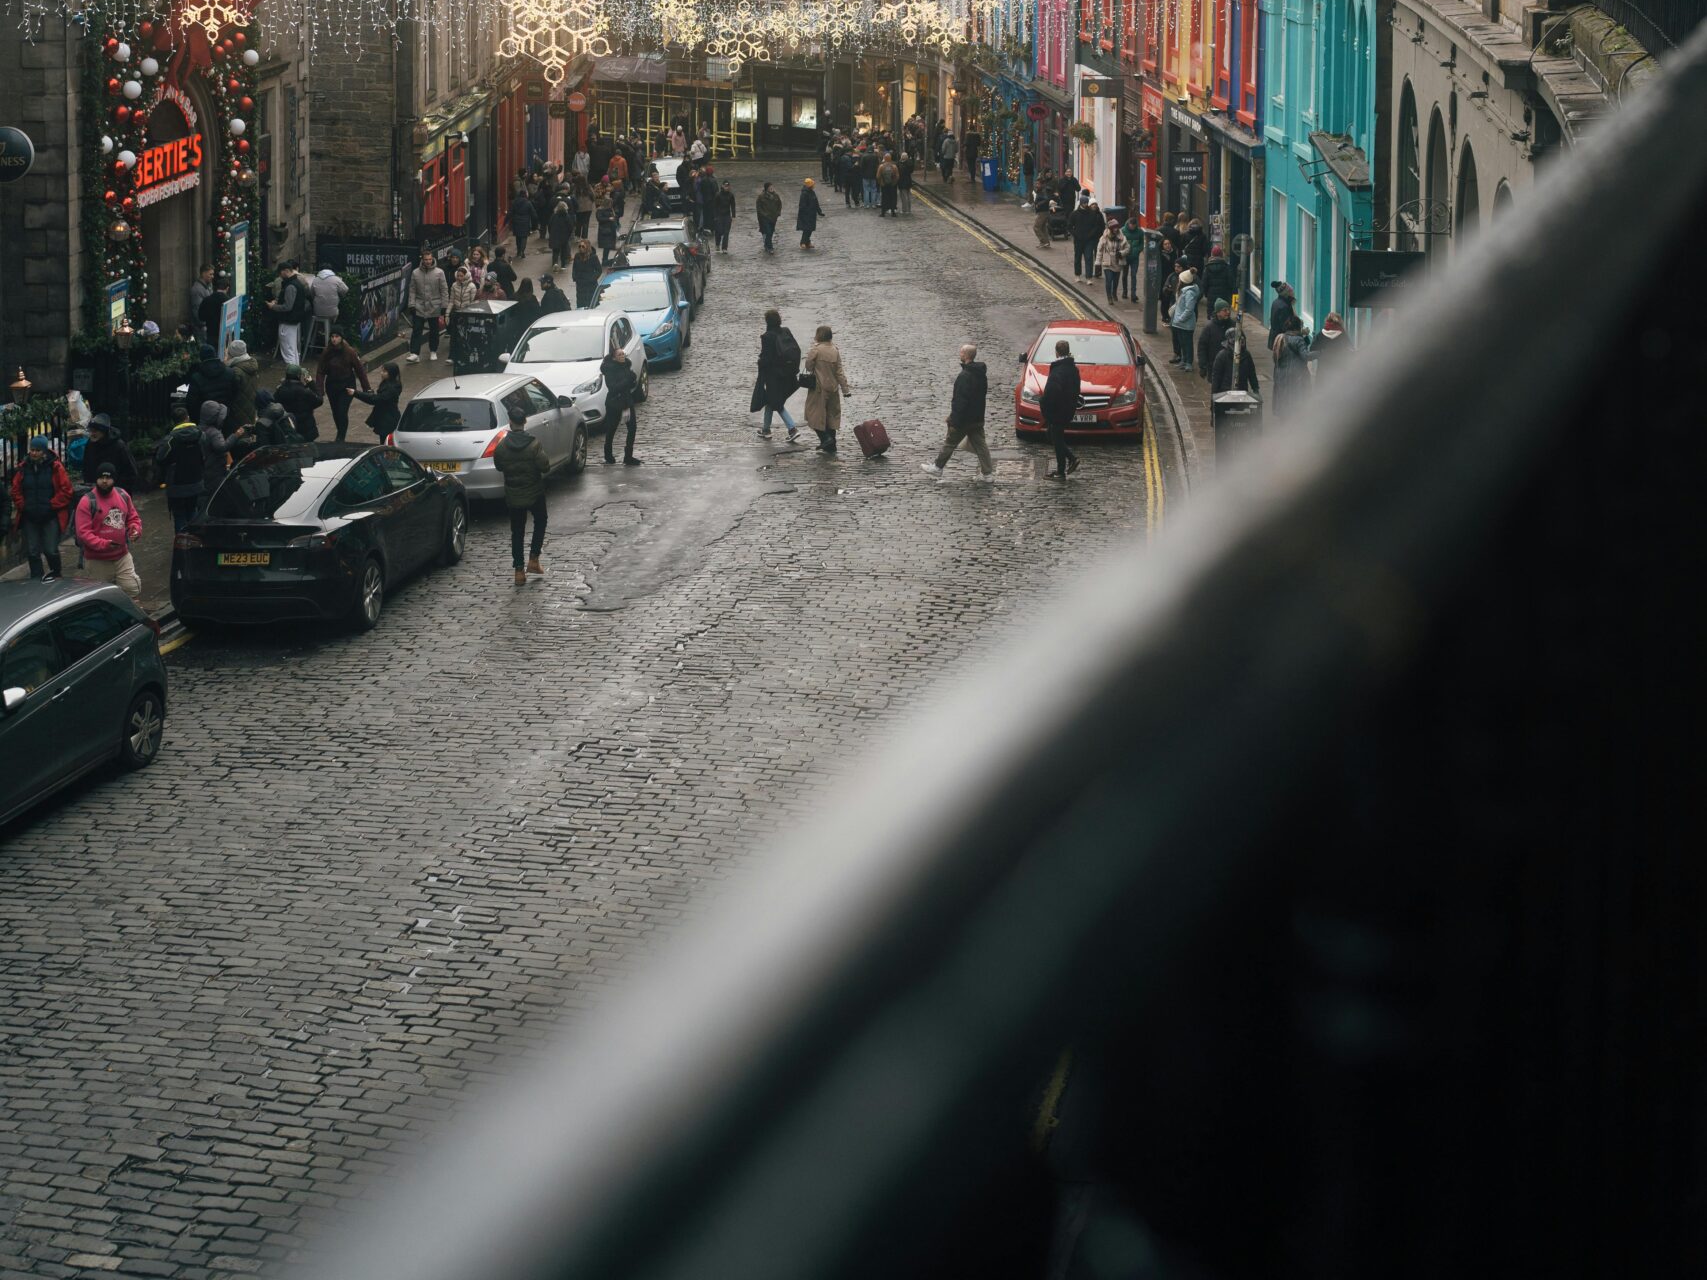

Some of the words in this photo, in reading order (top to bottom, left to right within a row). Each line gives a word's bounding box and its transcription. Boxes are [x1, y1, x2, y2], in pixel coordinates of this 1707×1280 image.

[1170, 106, 1178, 120] THE
[1178, 110, 1192, 128] WHISKY
[1191, 118, 1202, 132] SHOP
[159, 181, 174, 200] FISH
[180, 172, 200, 192] CHIPS
[346, 253, 374, 265] PLEASE
[223, 553, 248, 564] ME23
[250, 553, 269, 563] EUC
